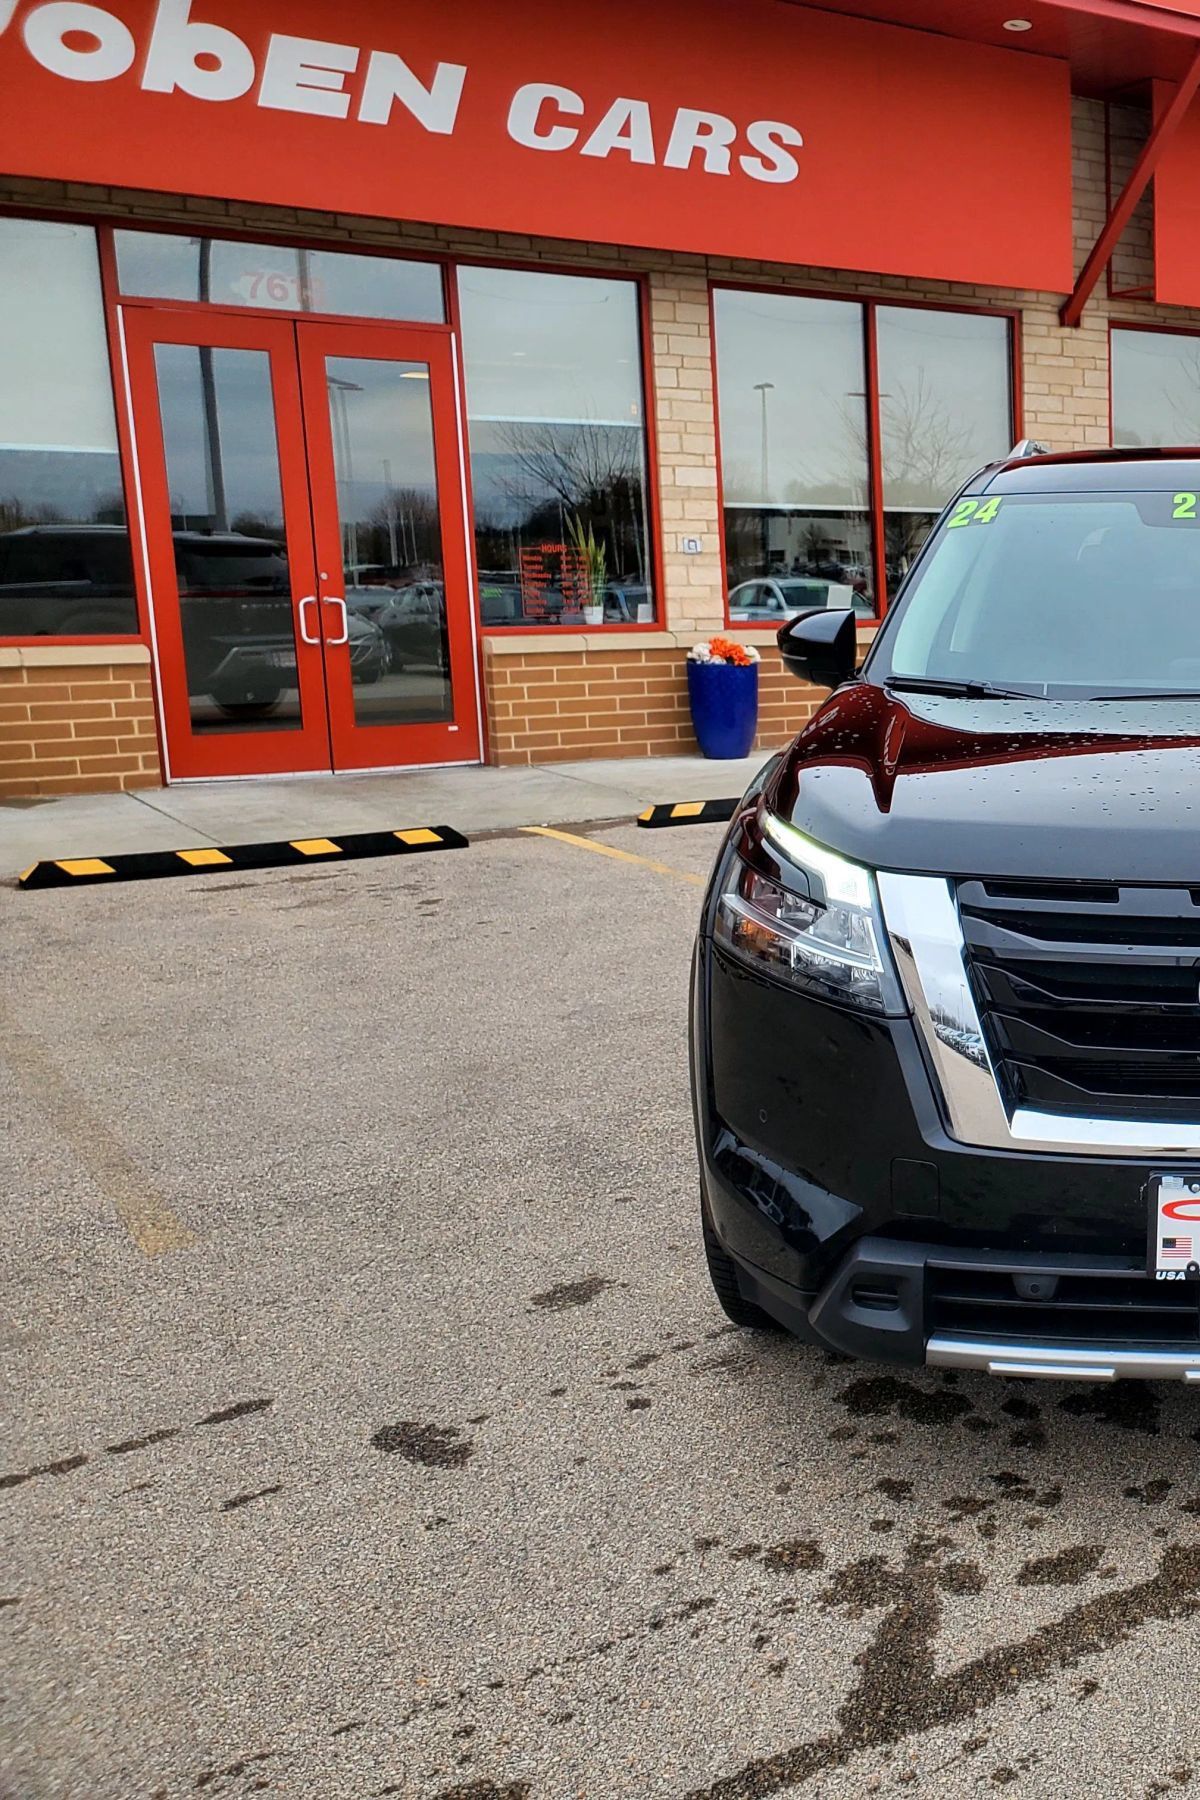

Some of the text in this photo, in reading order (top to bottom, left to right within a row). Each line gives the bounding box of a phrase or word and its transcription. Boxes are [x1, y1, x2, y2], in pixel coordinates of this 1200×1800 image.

[0, 0, 804, 184] obEN CARS
[946, 497, 1002, 529] 24
[541, 543, 568, 553] HOURS
[1155, 1271, 1187, 1282] USA
